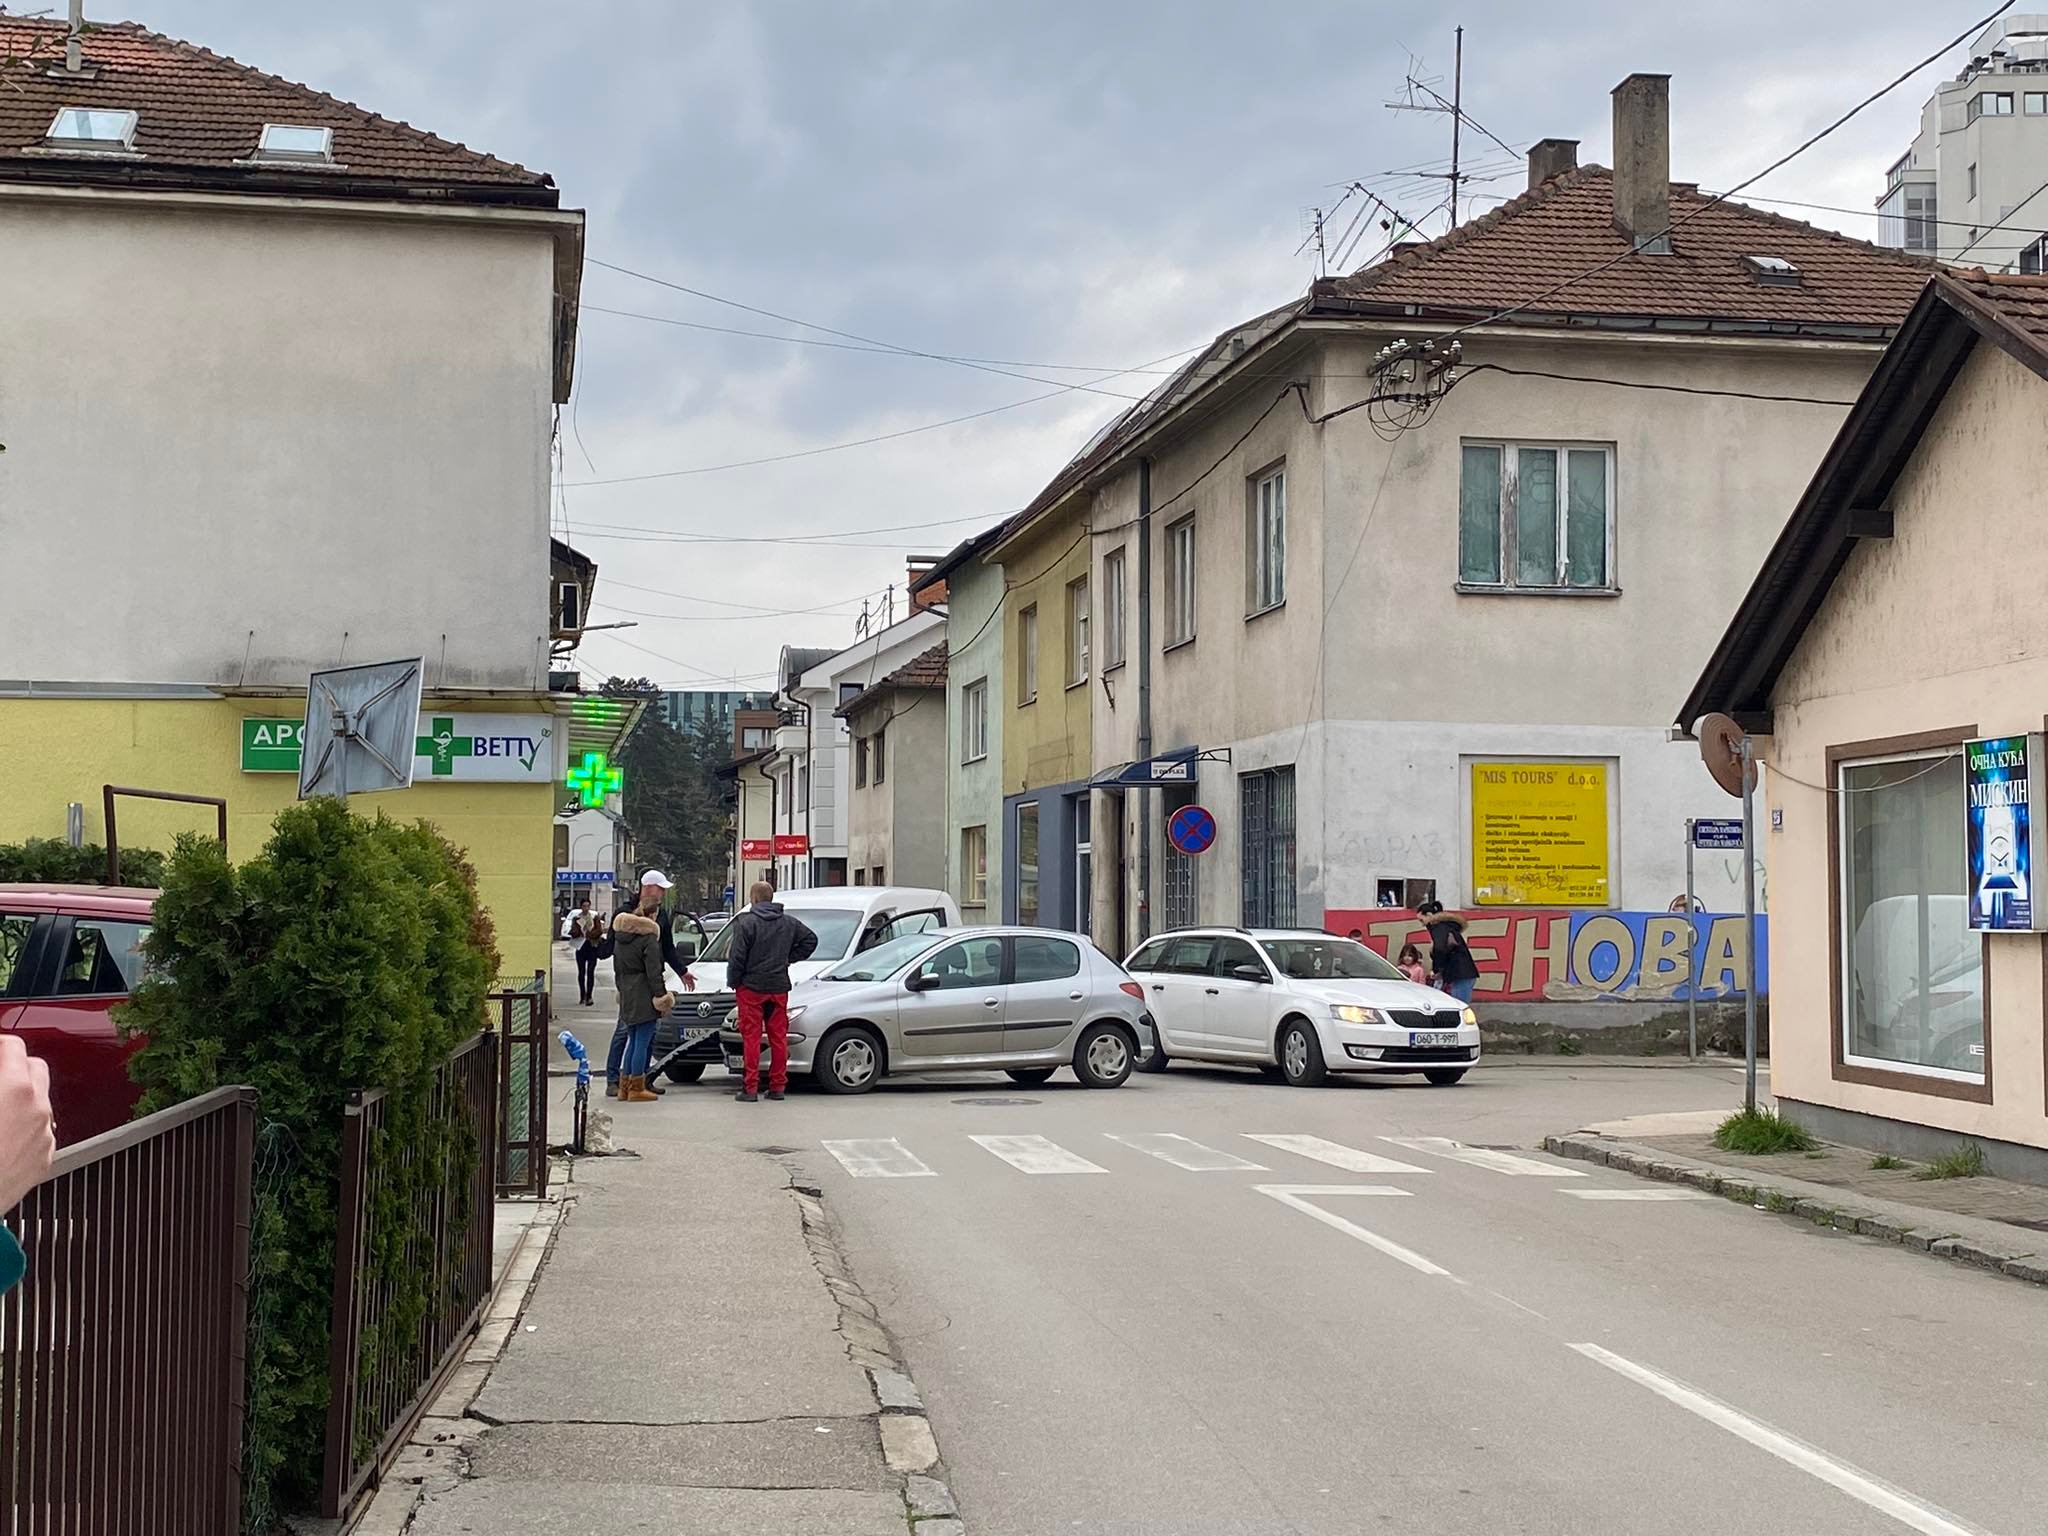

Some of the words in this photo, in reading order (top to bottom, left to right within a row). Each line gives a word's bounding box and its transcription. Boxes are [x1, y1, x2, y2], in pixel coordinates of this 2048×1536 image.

[474, 737, 544, 771] BETTY
[1970, 754, 1997, 771] ОЧНА
[1567, 772, 1601, 786] d.o.o.
[1970, 779, 2028, 808] МИСКИН
